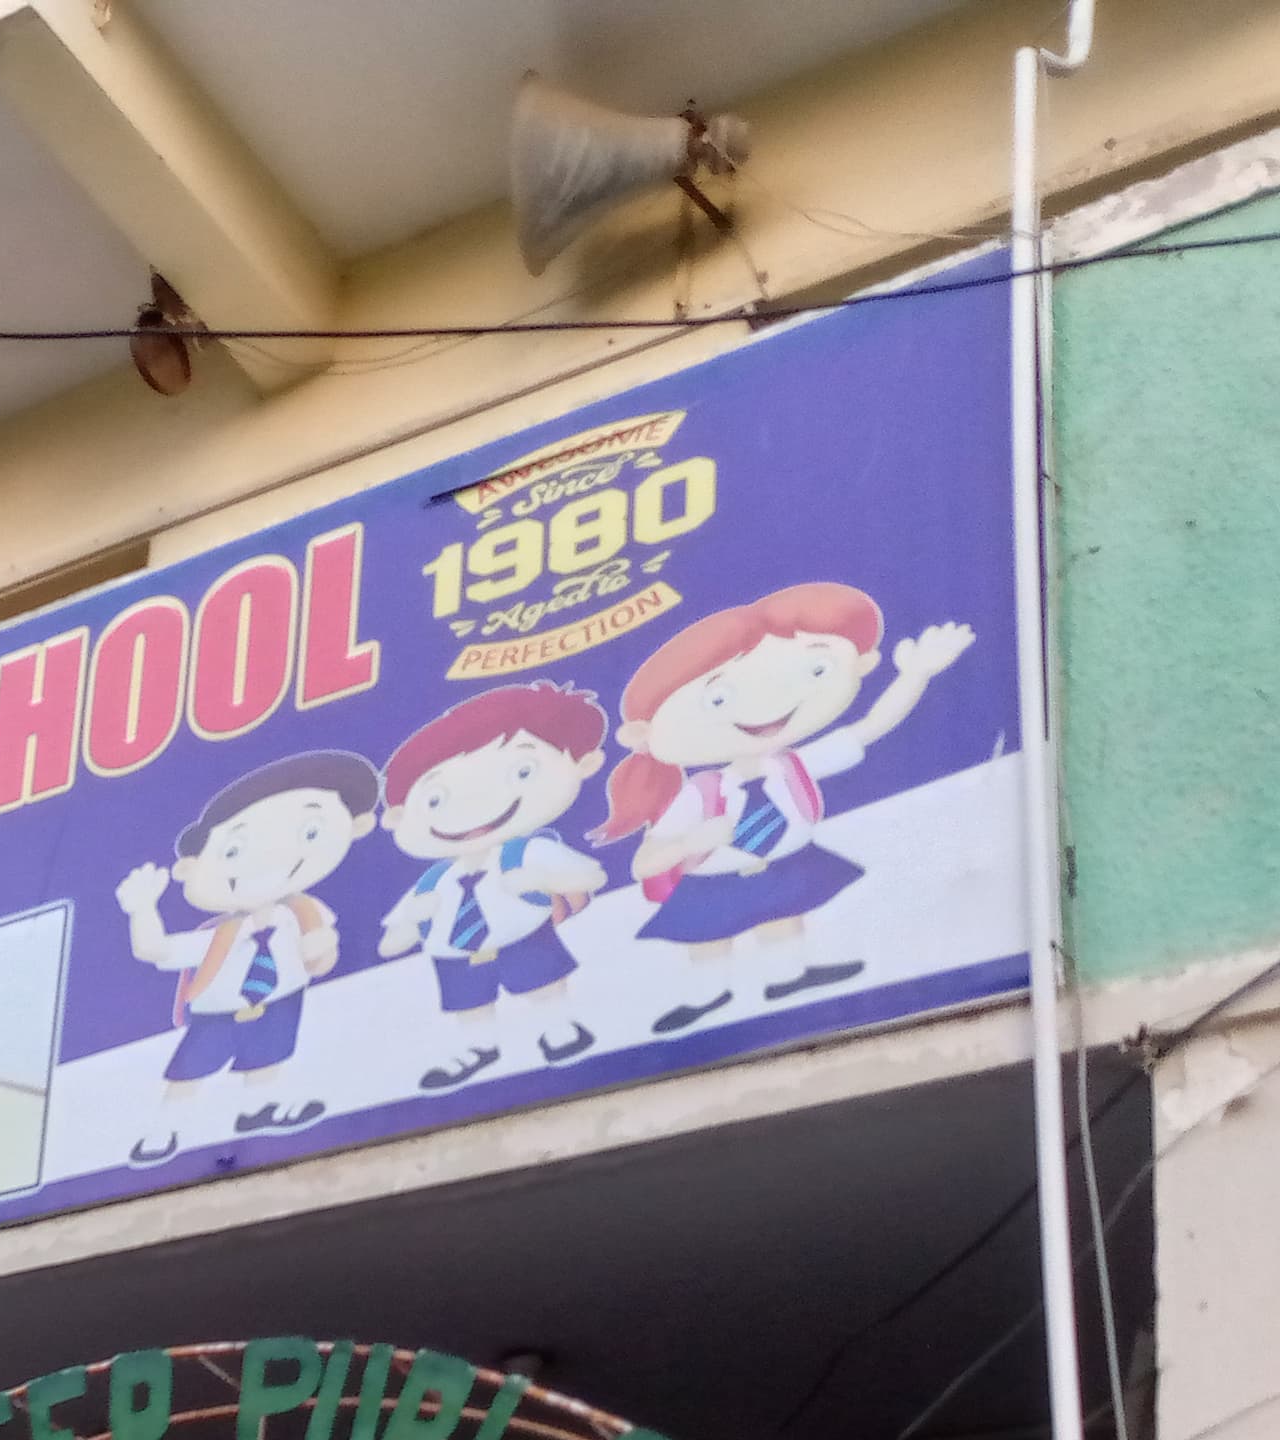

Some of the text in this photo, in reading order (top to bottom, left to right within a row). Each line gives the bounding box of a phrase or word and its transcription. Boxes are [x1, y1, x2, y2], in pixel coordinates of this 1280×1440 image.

[512, 451, 635, 517] Since
[422, 456, 716, 619] 1980
[461, 590, 663, 672] PERFECTION
